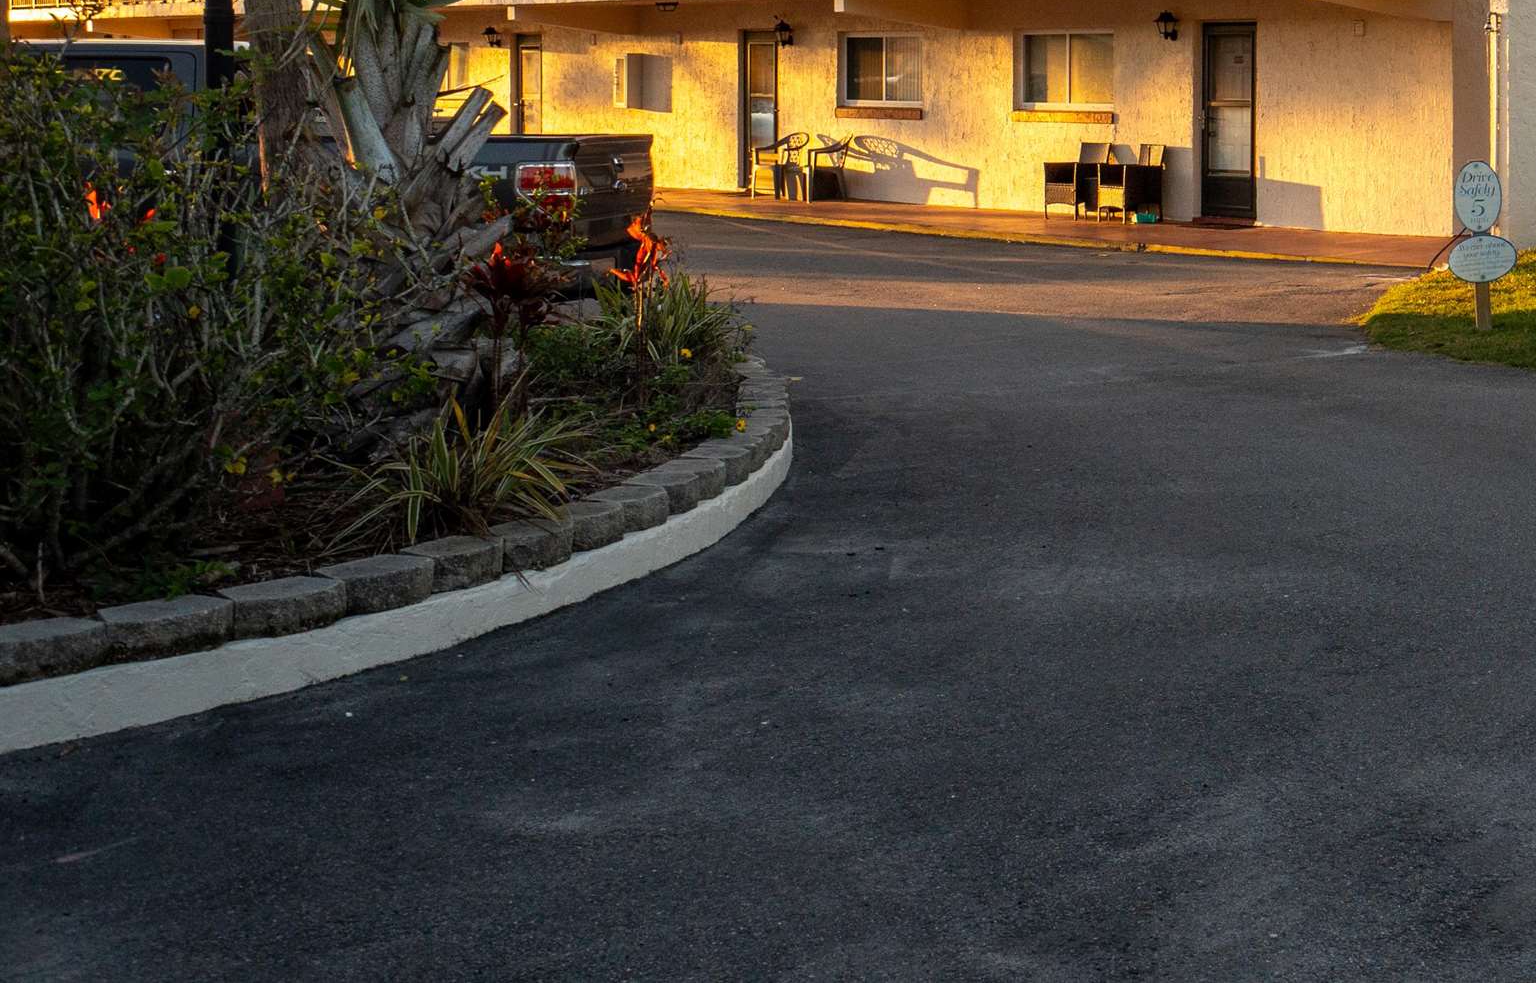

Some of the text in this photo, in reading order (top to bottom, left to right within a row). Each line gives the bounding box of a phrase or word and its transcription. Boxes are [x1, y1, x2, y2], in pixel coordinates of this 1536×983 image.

[1461, 171, 1495, 184] Drive
[1459, 183, 1496, 199] Safely
[1471, 199, 1486, 217] 5
